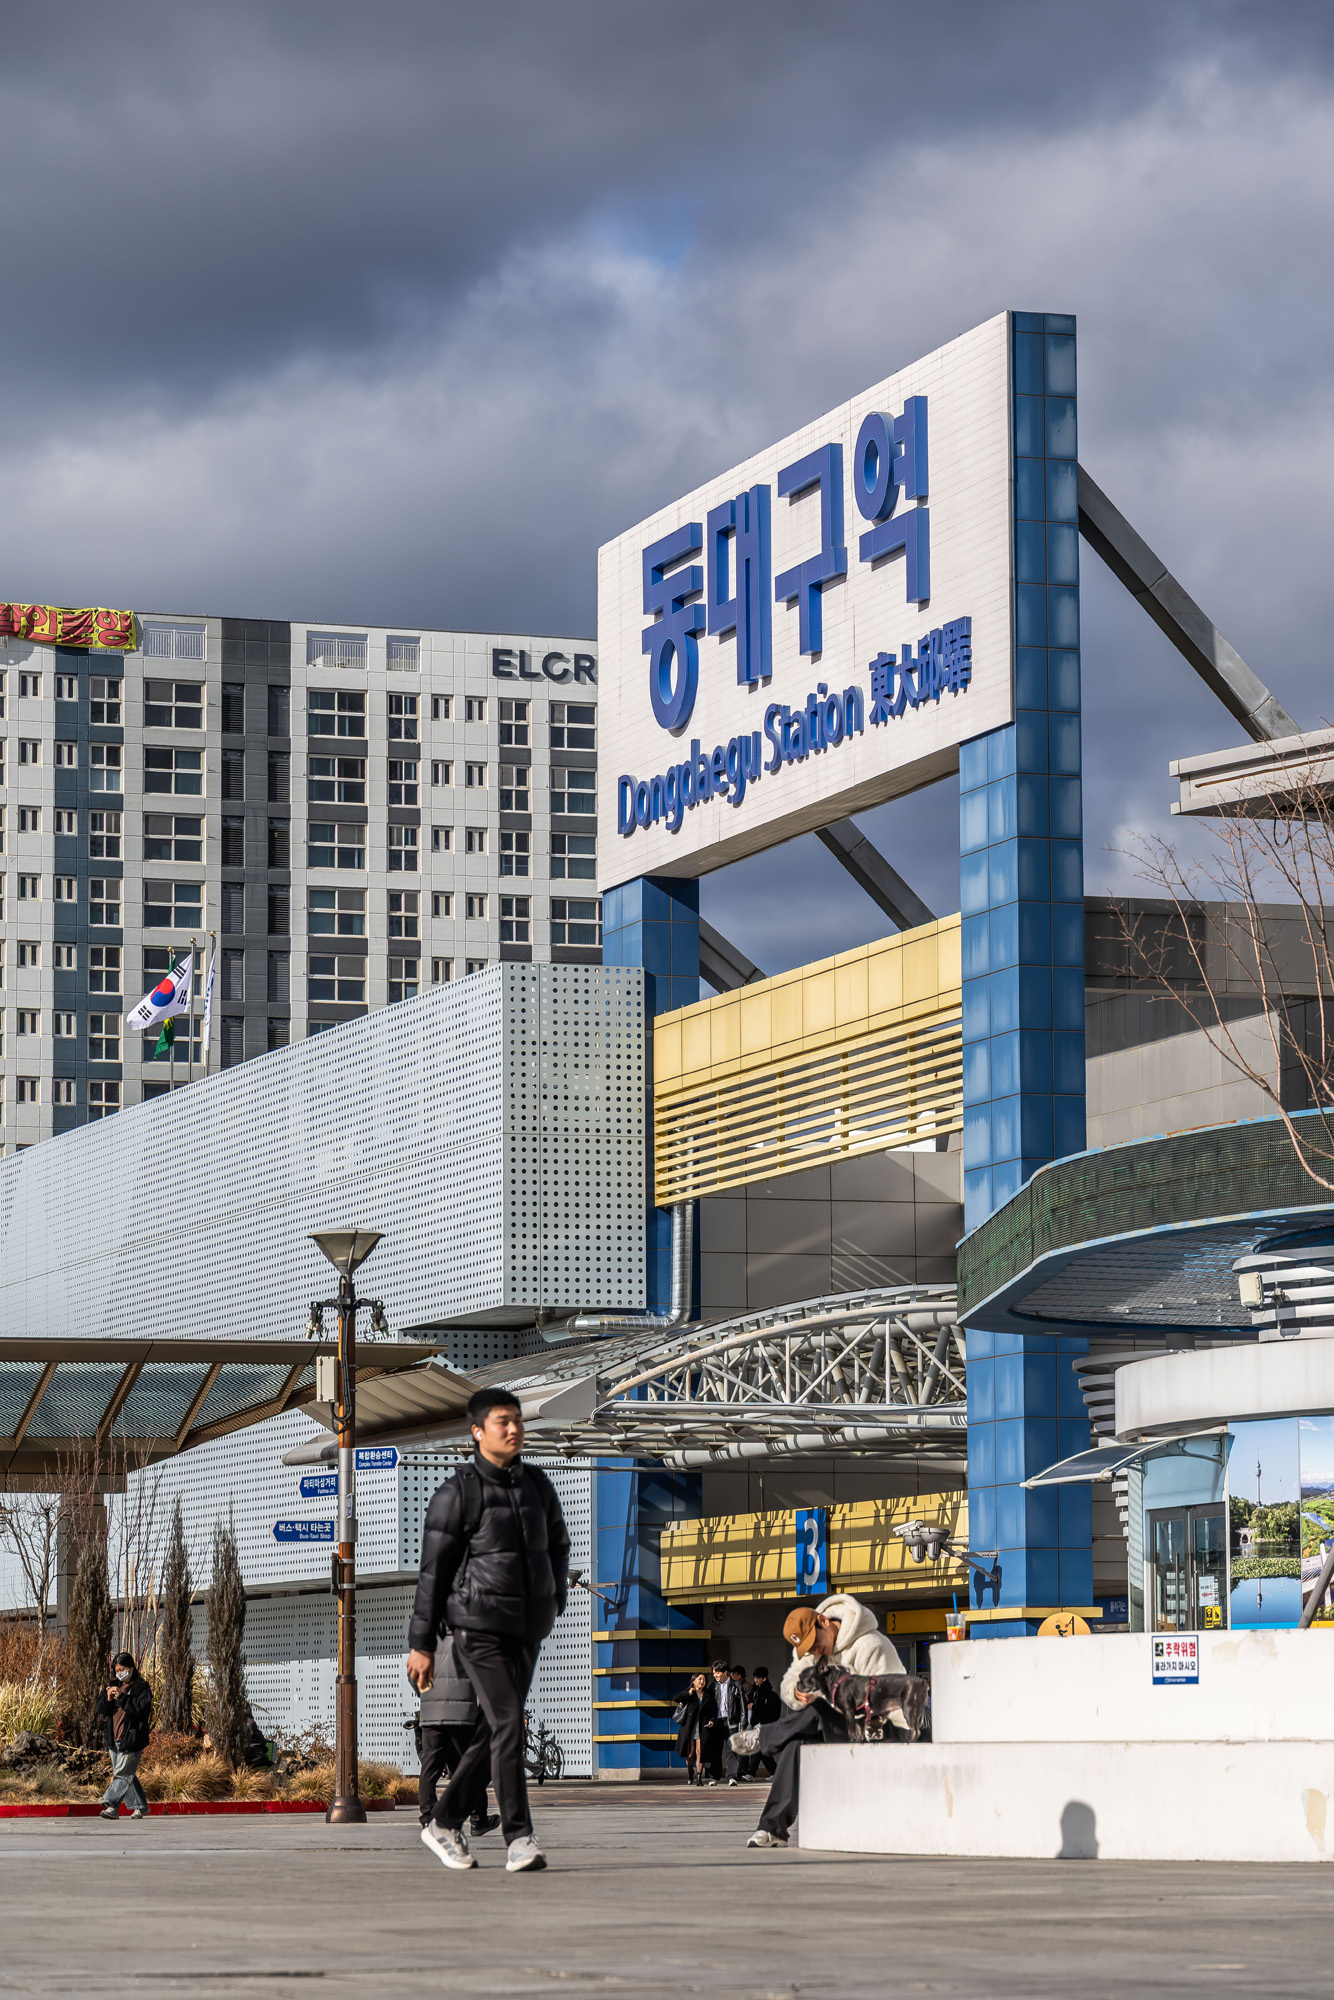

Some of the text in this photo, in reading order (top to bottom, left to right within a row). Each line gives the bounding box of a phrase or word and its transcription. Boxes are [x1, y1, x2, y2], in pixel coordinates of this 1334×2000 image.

[641, 395, 931, 732] 동대구역
[617, 682, 864, 834] Dongdaegu Station
[1106, 1156, 1160, 1218] 문의
[358, 1450, 393, 1460] 복합환승센터
[303, 1477, 335, 1489] 파티마삼거리
[310, 1522, 331, 1533] 타는곳
[803, 1518, 820, 1586] 3
[891, 1613, 896, 1632] 3
[1166, 1642, 1196, 1657] 추락위험
[1155, 1661, 1196, 1671] 올라가지 마시오
